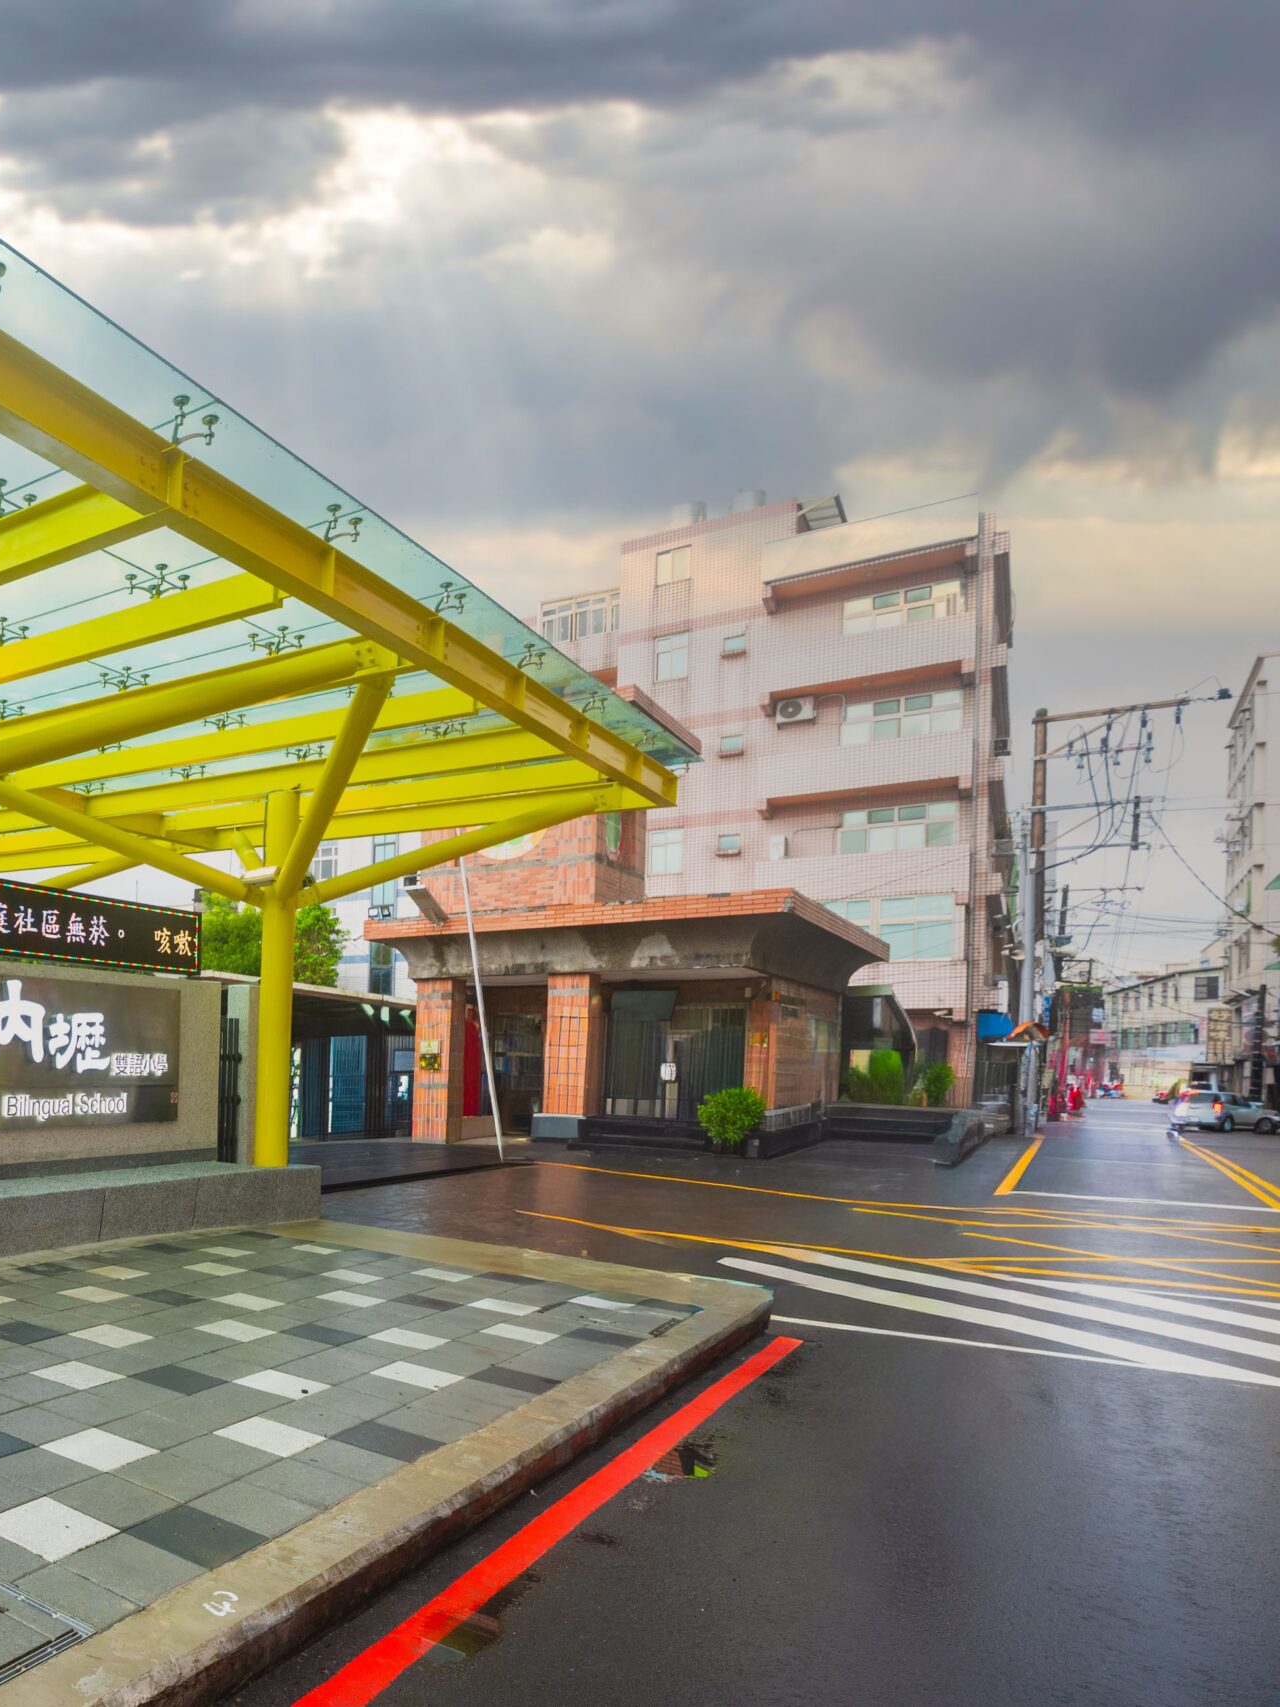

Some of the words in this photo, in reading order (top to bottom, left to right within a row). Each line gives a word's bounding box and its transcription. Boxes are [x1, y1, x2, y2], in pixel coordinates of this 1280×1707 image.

[154, 927, 198, 957] 咳嗽
[110, 1052, 168, 1076] 雙語小學
[2, 1093, 73, 1122] Bilingual
[75, 1091, 128, 1115] School
